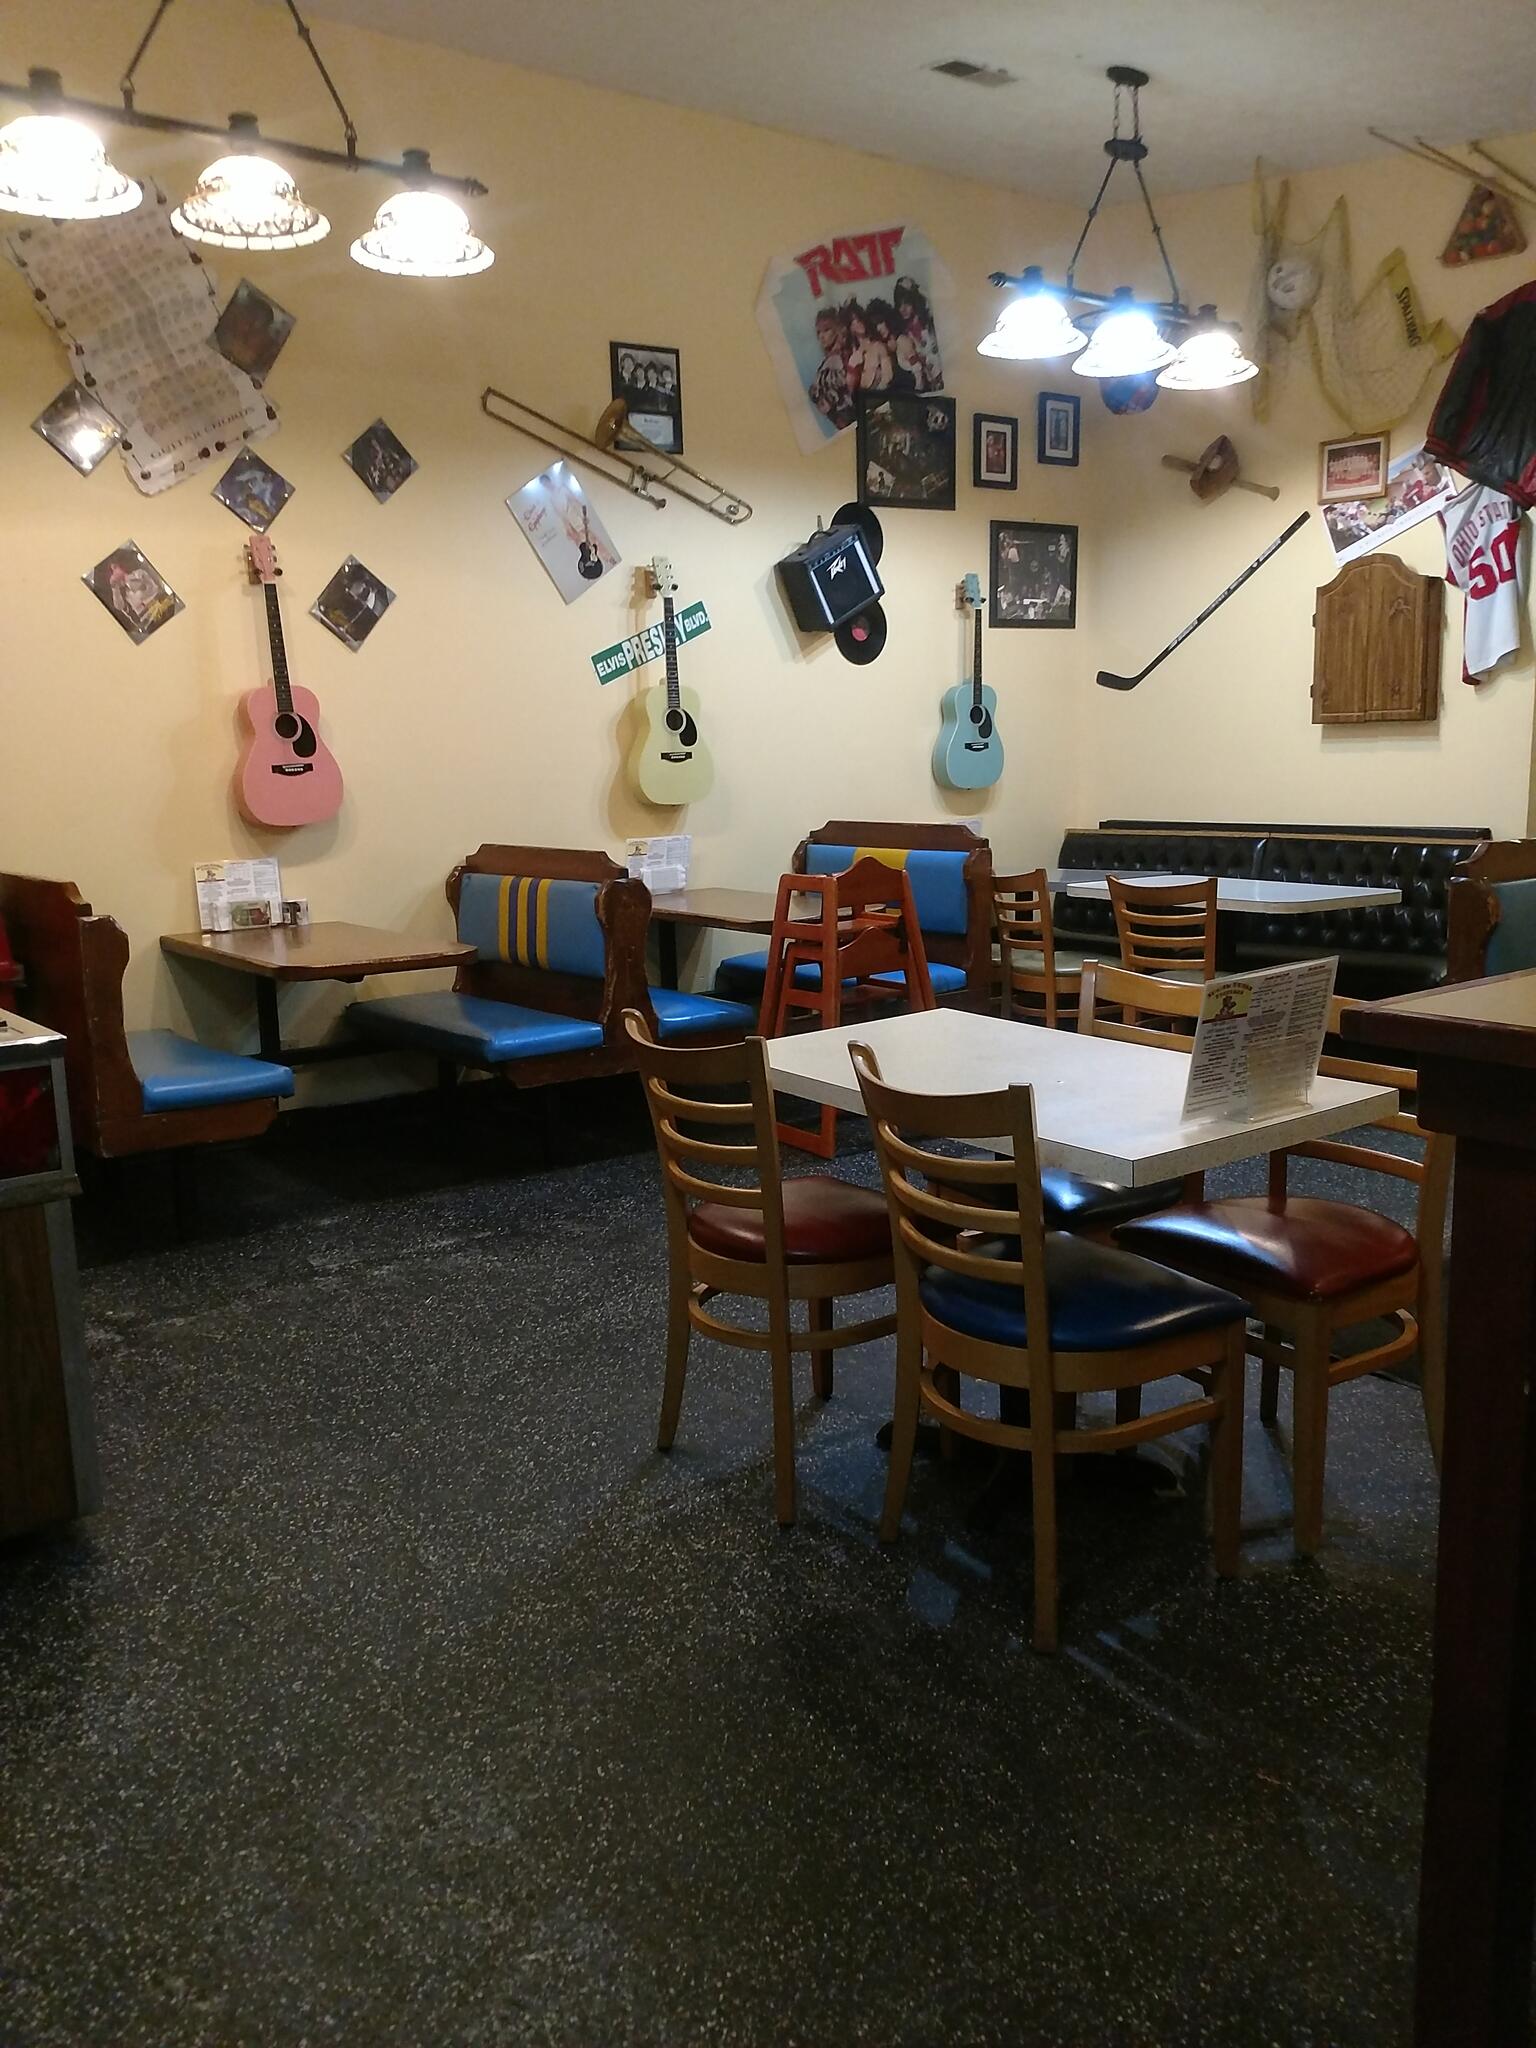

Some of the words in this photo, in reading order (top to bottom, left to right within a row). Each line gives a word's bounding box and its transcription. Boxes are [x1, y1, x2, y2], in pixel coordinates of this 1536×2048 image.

[793, 225, 905, 299] RATT
[1395, 286, 1422, 348] SPALDING
[1452, 521, 1479, 568] OHIO
[1478, 500, 1512, 528] STAT
[1468, 521, 1520, 600] 50
[596, 652, 626, 677] ELVIS
